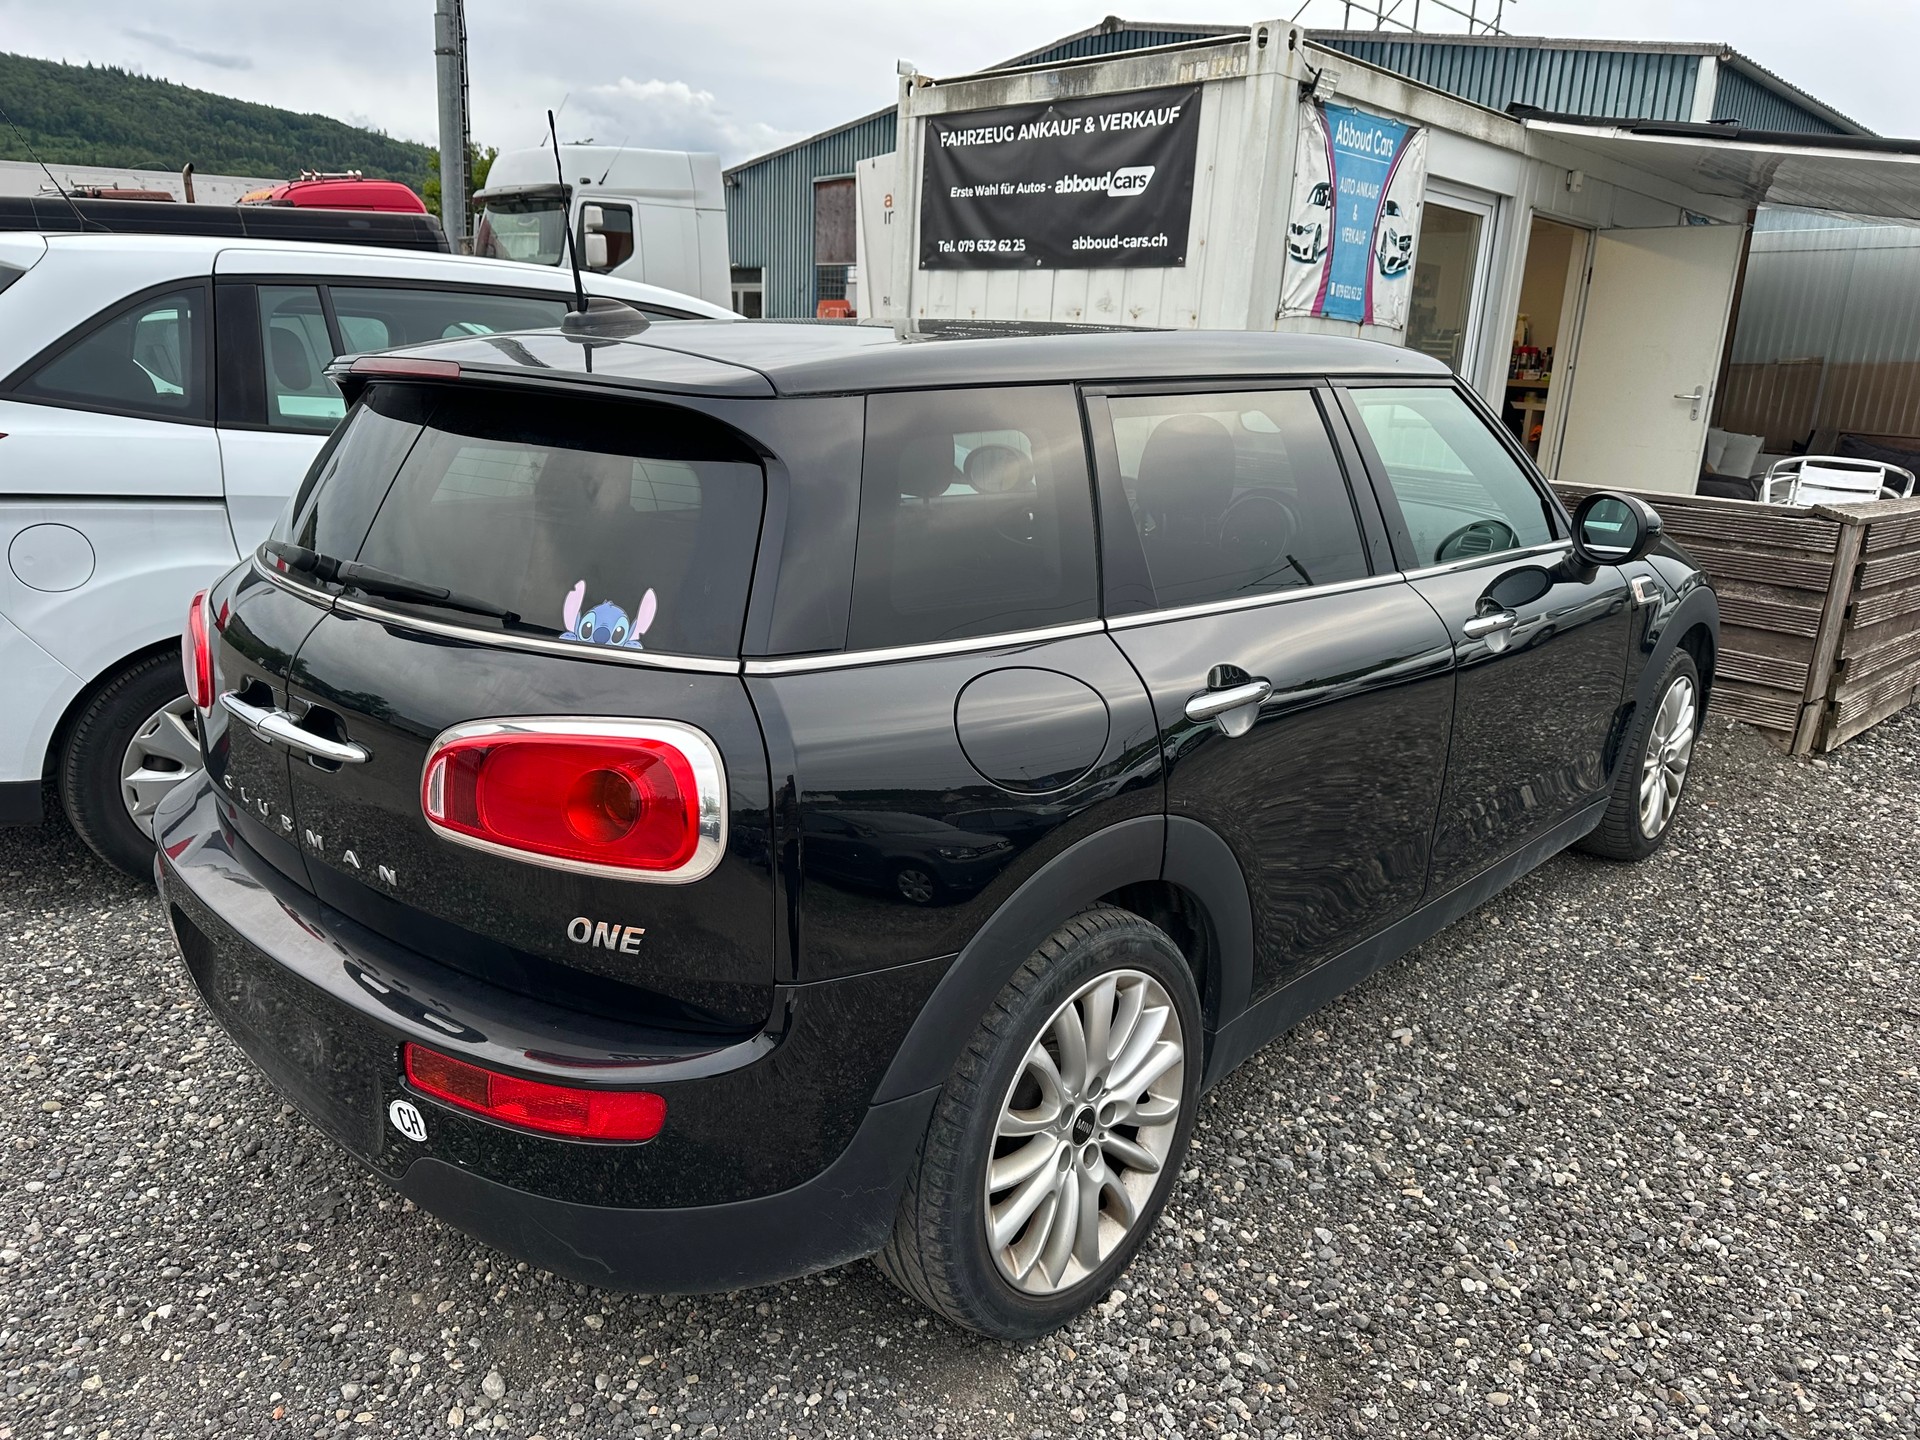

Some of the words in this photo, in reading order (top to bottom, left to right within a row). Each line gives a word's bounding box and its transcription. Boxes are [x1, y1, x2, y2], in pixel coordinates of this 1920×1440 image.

[940, 125, 1015, 147] FAHRZEUG
[1017, 118, 1081, 140] ANKAUF
[1084, 116, 1095, 133] &
[1099, 106, 1181, 132] VERKAUF
[1335, 119, 1374, 152] Abboud
[1373, 130, 1394, 158] Cars
[950, 185, 974, 198] Erste
[974, 183, 999, 196] Wahl
[1000, 182, 1015, 195] für
[1016, 181, 1046, 194] Autos
[1339, 177, 1356, 195] AUTO
[1356, 181, 1380, 199] ANKAUF
[938, 240, 956, 252] Tel.
[958, 240, 975, 252] 079
[977, 239, 997, 252] 632
[998, 239, 1012, 252] 62
[1012, 238, 1026, 251] 25
[1072, 233, 1168, 251] abboud-cars.ch
[1341, 226, 1367, 246] VERKAUF
[222, 773, 399, 887] CLUBMAN
[566, 915, 646, 956] ONE
[396, 1106, 423, 1137] CH
[1076, 1118, 1093, 1135] MINI
